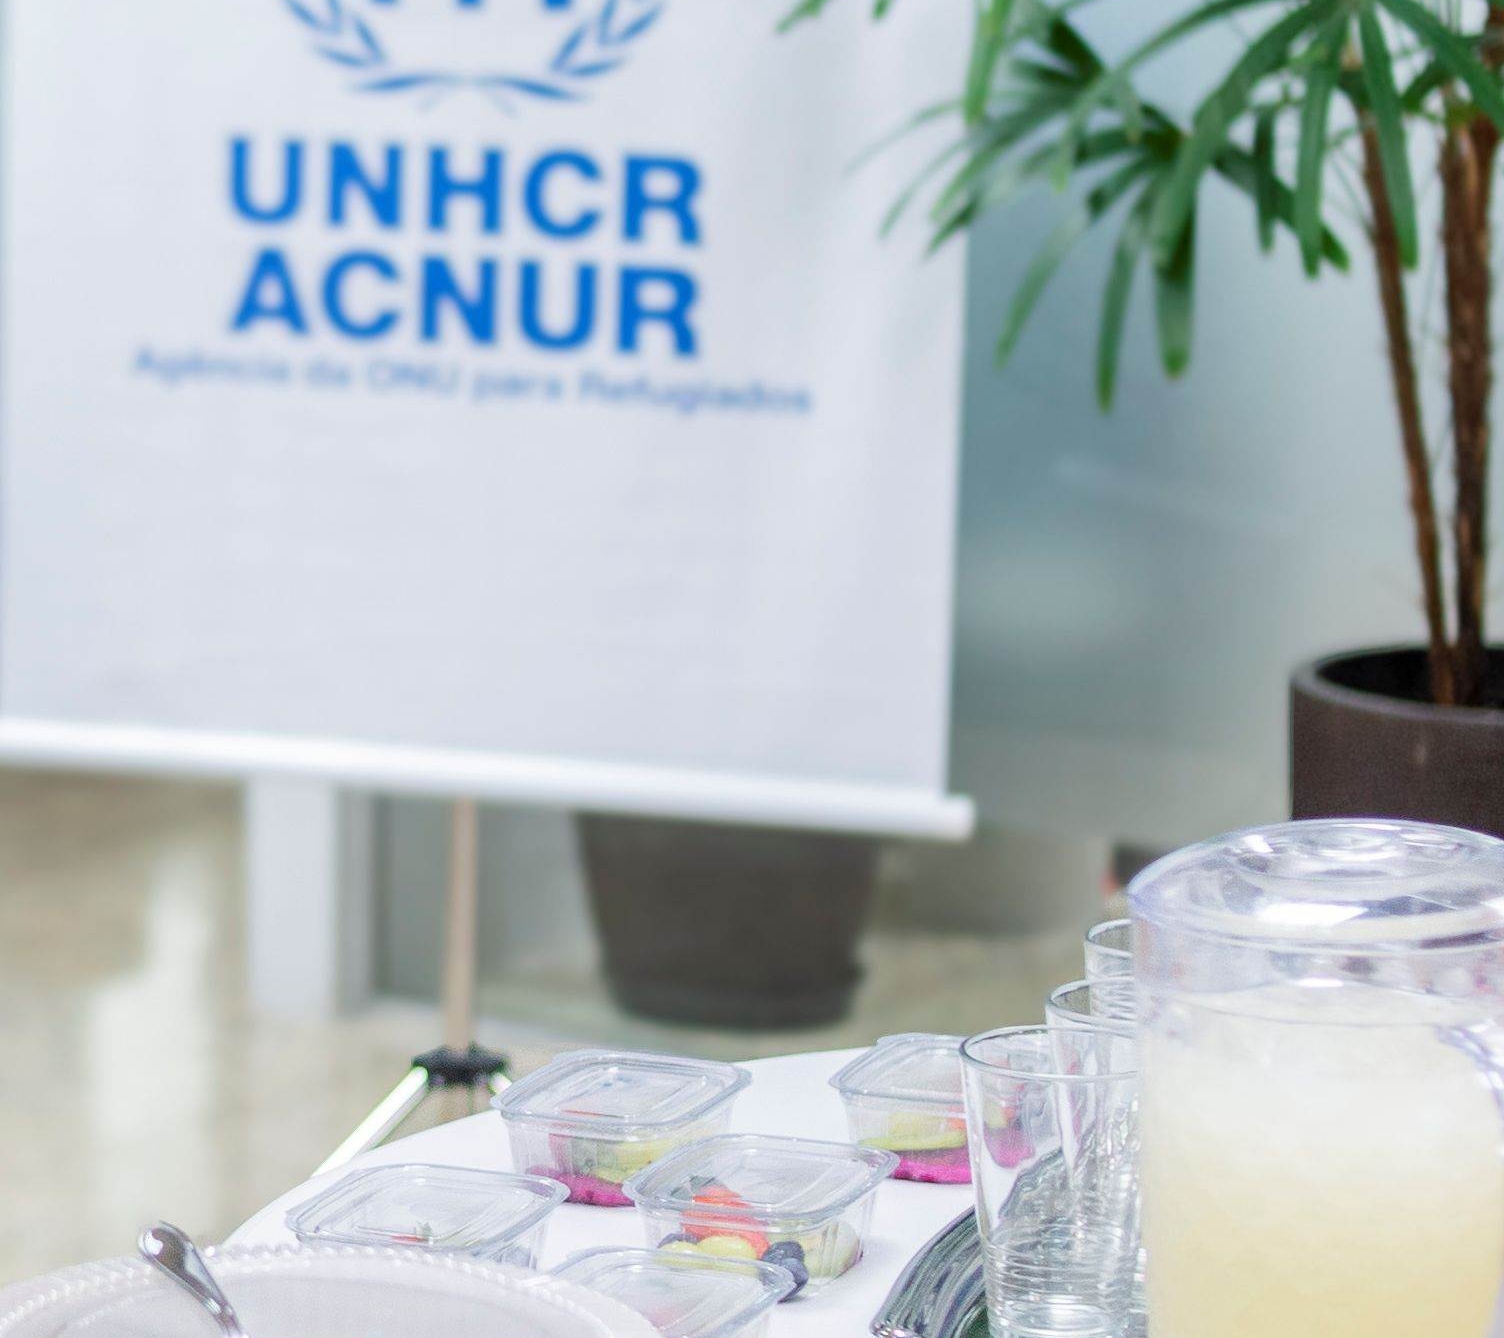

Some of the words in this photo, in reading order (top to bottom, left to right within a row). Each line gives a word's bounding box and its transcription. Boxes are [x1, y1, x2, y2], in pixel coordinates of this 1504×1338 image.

[227, 136, 704, 247] UNHCR
[229, 244, 701, 359] ACNUR
[134, 346, 291, 389] Agência
[304, 356, 351, 389] da
[366, 359, 459, 393] ONU
[472, 372, 563, 404] para
[580, 367, 812, 415] Refugiados
